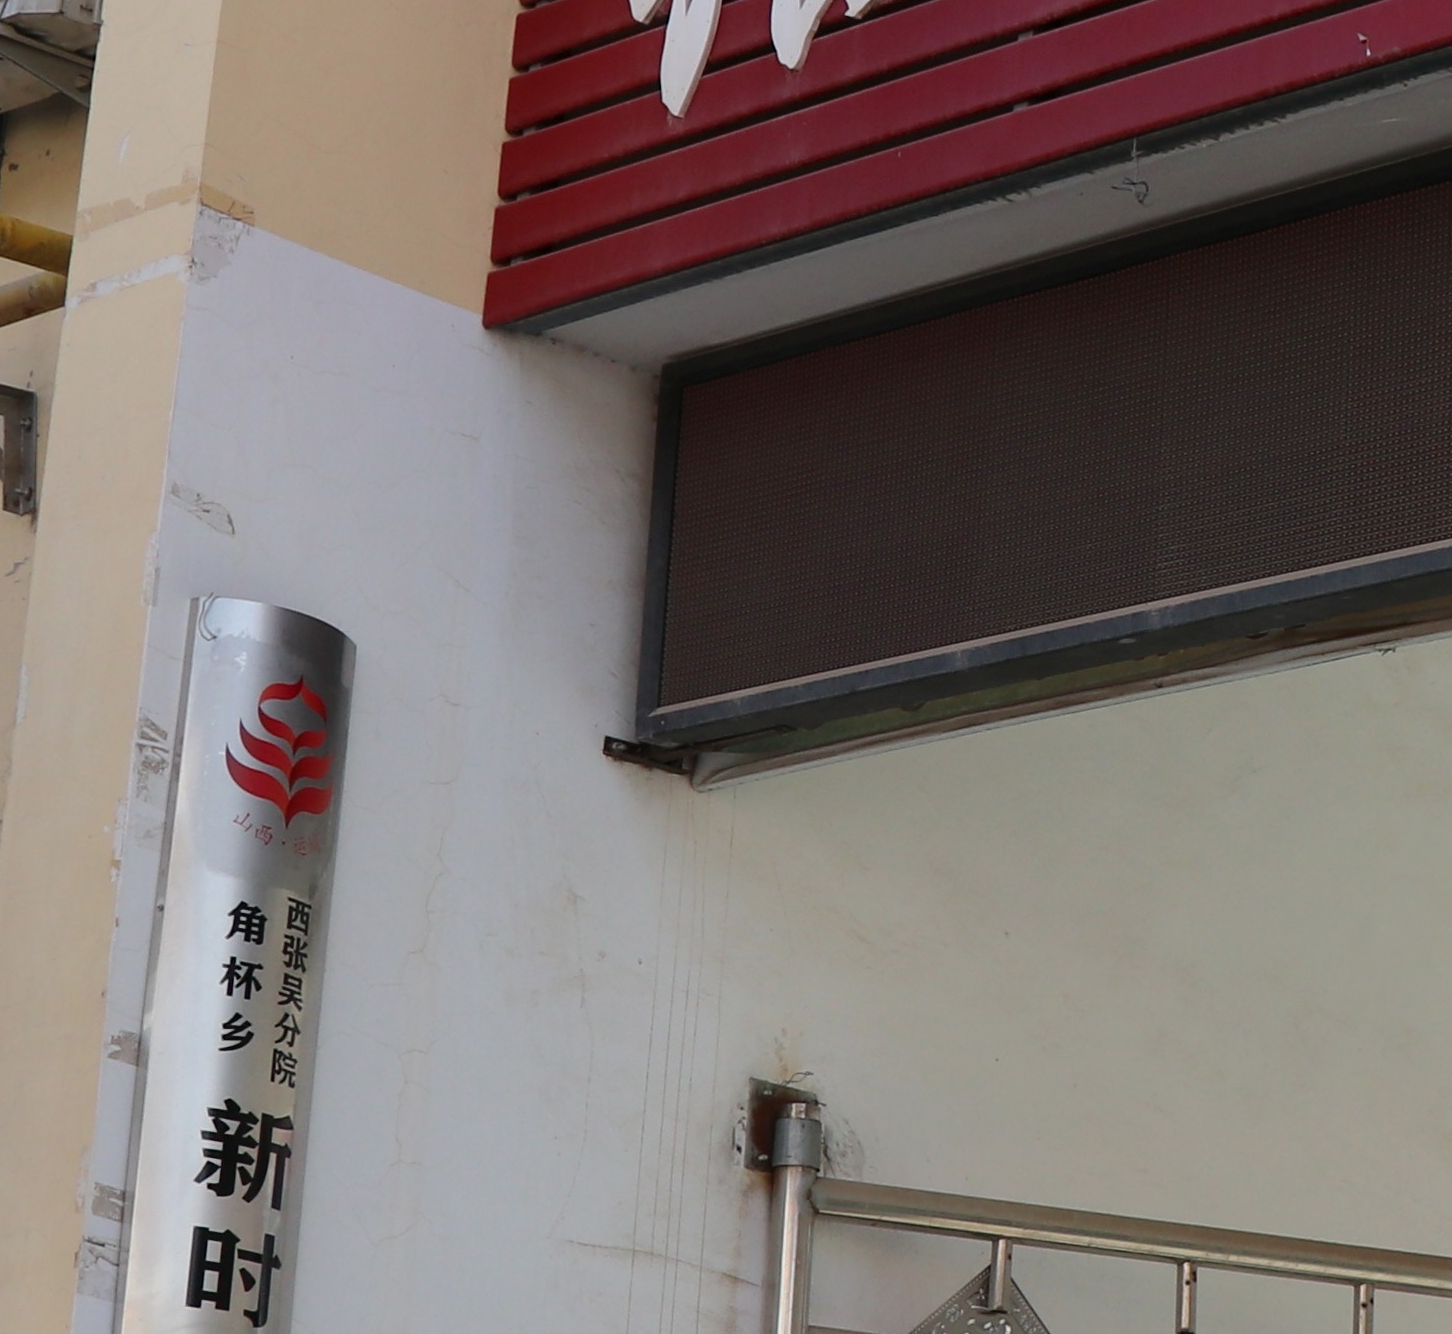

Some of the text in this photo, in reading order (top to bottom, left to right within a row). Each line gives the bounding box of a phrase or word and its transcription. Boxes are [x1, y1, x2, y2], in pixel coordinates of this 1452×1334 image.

[217, 899, 268, 1053] 角杯乡
[270, 896, 312, 1090] 西张吴分院
